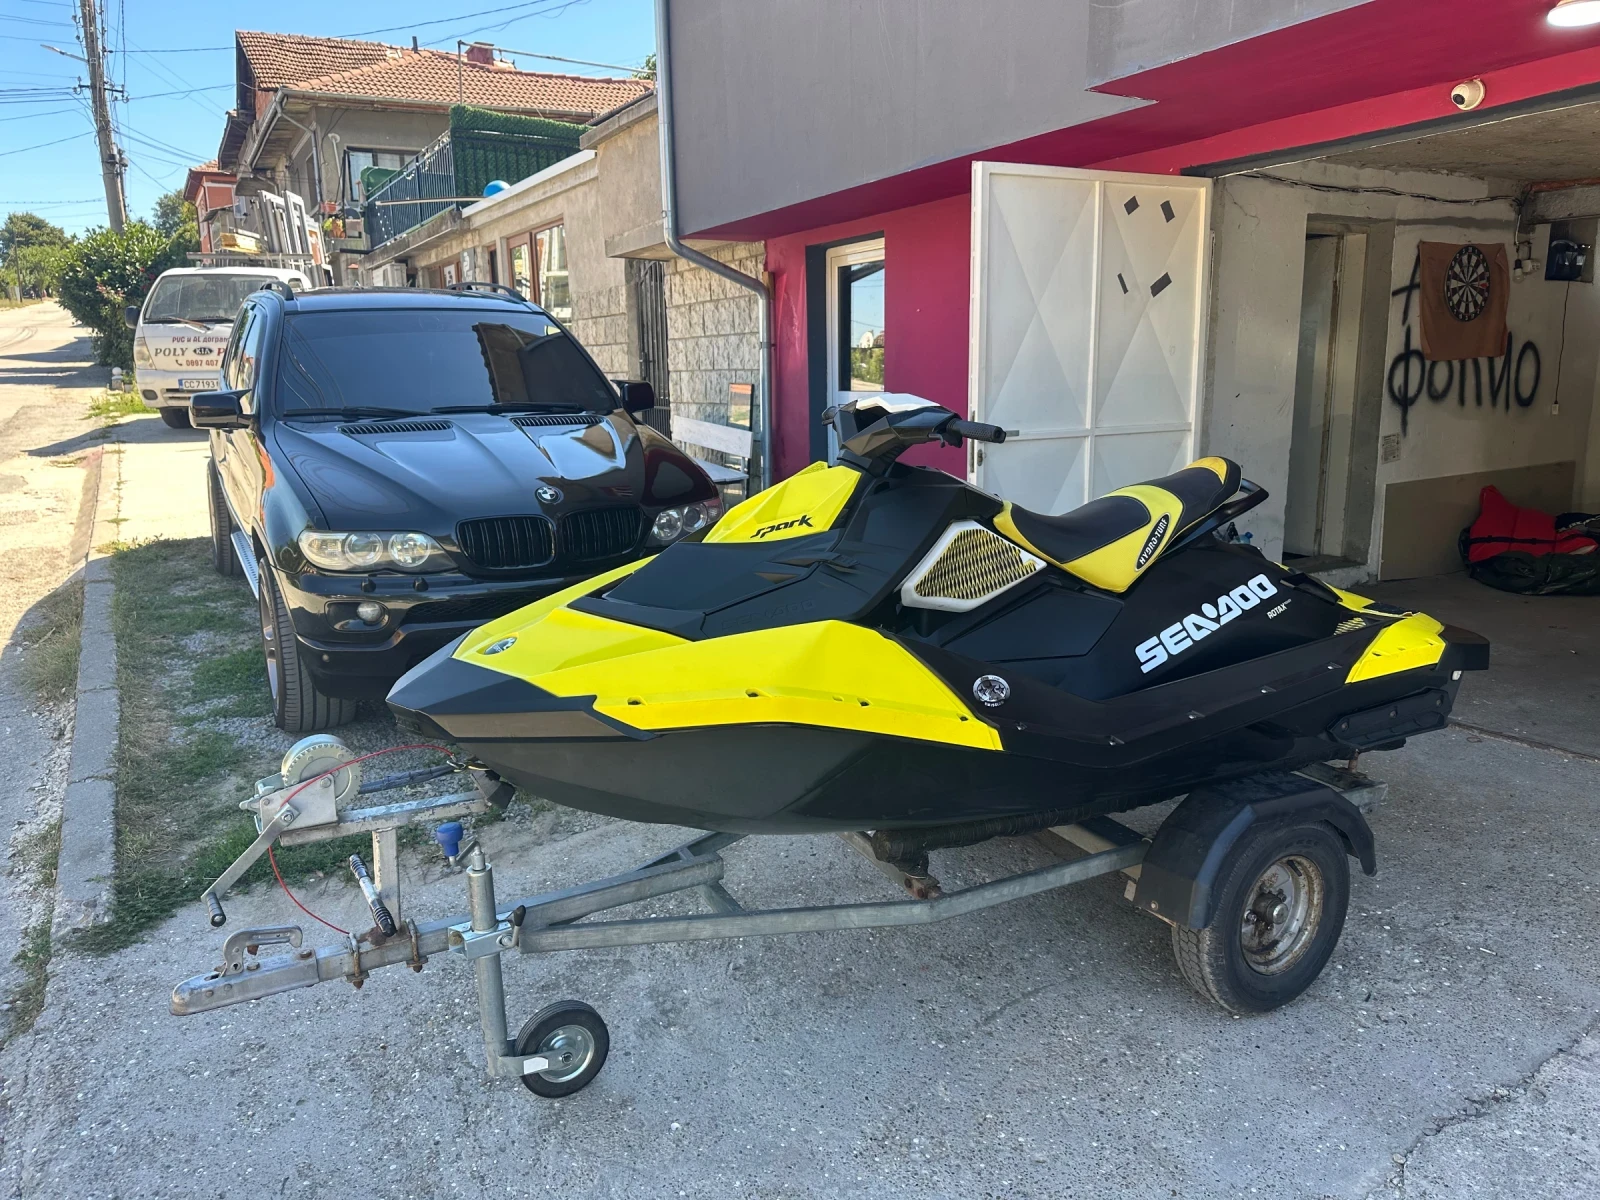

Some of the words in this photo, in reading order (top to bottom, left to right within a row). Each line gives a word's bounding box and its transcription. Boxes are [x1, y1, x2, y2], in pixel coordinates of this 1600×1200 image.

[155, 348, 188, 356] POLY
[1139, 518, 1168, 565] HYDRO-TURF
[1266, 603, 1288, 620] ROTAX
